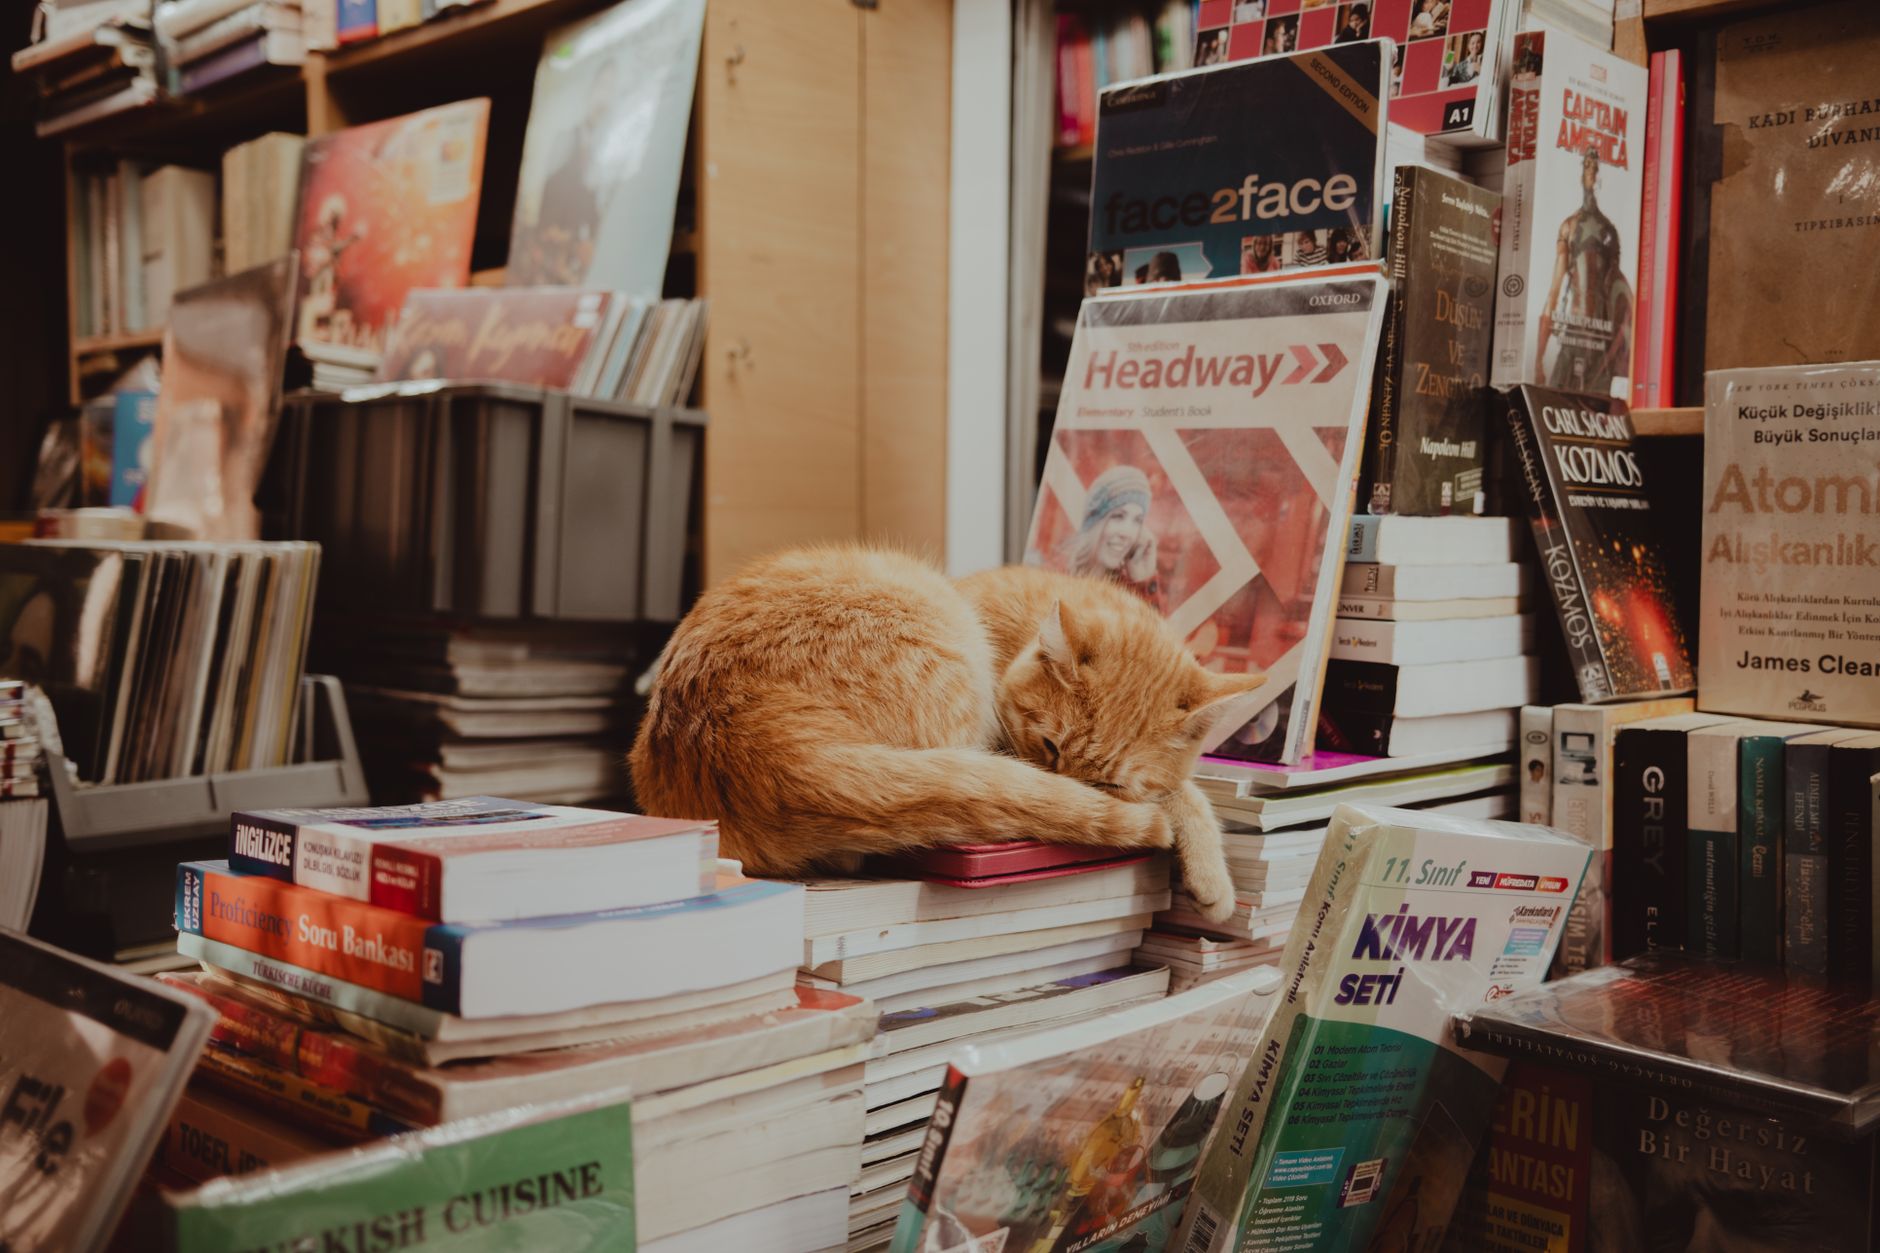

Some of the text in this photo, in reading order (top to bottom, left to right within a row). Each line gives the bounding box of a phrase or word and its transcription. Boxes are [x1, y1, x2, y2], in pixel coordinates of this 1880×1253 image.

[1310, 58, 1371, 114] SECOND EDITION
[1448, 107, 1470, 125] A1
[1507, 88, 1526, 167] AMERICA
[1520, 88, 1540, 161] CAPTAIN
[1562, 88, 1628, 138] CAPTAIN
[1749, 110, 1796, 129] KADI
[1556, 118, 1628, 171] AMERICA
[1104, 173, 1358, 236] face2face
[1394, 186, 1411, 279] Napoleon Hill
[1309, 293, 1361, 307] OXFORD
[1083, 344, 1285, 399] Headway
[1077, 406, 1135, 419] Elementary
[1187, 405, 1212, 417] Book
[1542, 406, 1631, 441] CARL SAGAN
[1738, 405, 1788, 422] Küçük
[1420, 437, 1476, 460] Napoleon Hill
[1507, 408, 1546, 502] CARL SAGAN
[1754, 429, 1803, 446] Büyük
[1553, 445, 1643, 487] KOZMOS
[1545, 544, 1593, 650] KOZMOS
[1796, 611, 1840, 622] Edinmek
[1842, 611, 1862, 624] İçin
[1828, 629, 1843, 640] Bir
[1737, 650, 1810, 672] James
[1755, 757, 1765, 798] NAMIK
[1642, 765, 1665, 877] GREY
[1794, 792, 1805, 832] EFENDİ
[1381, 856, 1467, 887] 11. Sınıf
[1475, 874, 1493, 886] YENİ
[1752, 845, 1767, 878] Cezmi
[183, 870, 192, 929] EKREM
[192, 876, 200, 929] UZBAY
[1311, 899, 1331, 938] Konu
[210, 891, 415, 973] Proficiency Soru Bankası
[1352, 903, 1478, 961] KİMYA
[301, 970, 331, 999] KÜCHE
[1334, 966, 1403, 1006] SETİ
[1309, 1059, 1348, 1069] 02 Gazlar
[1313, 1045, 1325, 1055] 01
[1327, 1045, 1357, 1055] Modern
[1357, 1044, 1378, 1054] Atom
[1298, 1087, 1310, 1097] 04
[1311, 1086, 1346, 1098] Kimyasal
[1304, 1073, 1315, 1083] 03
[1229, 1039, 1281, 1157] KİMYA SETİ
[1293, 1101, 1305, 1111] 05
[1306, 1100, 1341, 1112] Kimyasal
[1300, 1114, 1338, 1126] Kimyasal
[1648, 1095, 1810, 1156] Değersiz
[180, 1122, 233, 1173] TOEFL
[1638, 1129, 1817, 1196] Bir Hayat
[443, 1161, 605, 1234] CUISINE
[1258, 1206, 1284, 1215] Öğrenme
[1295, 1194, 1308, 1202] Soru
[1520, 1213, 1564, 1237] DÜNYACA
